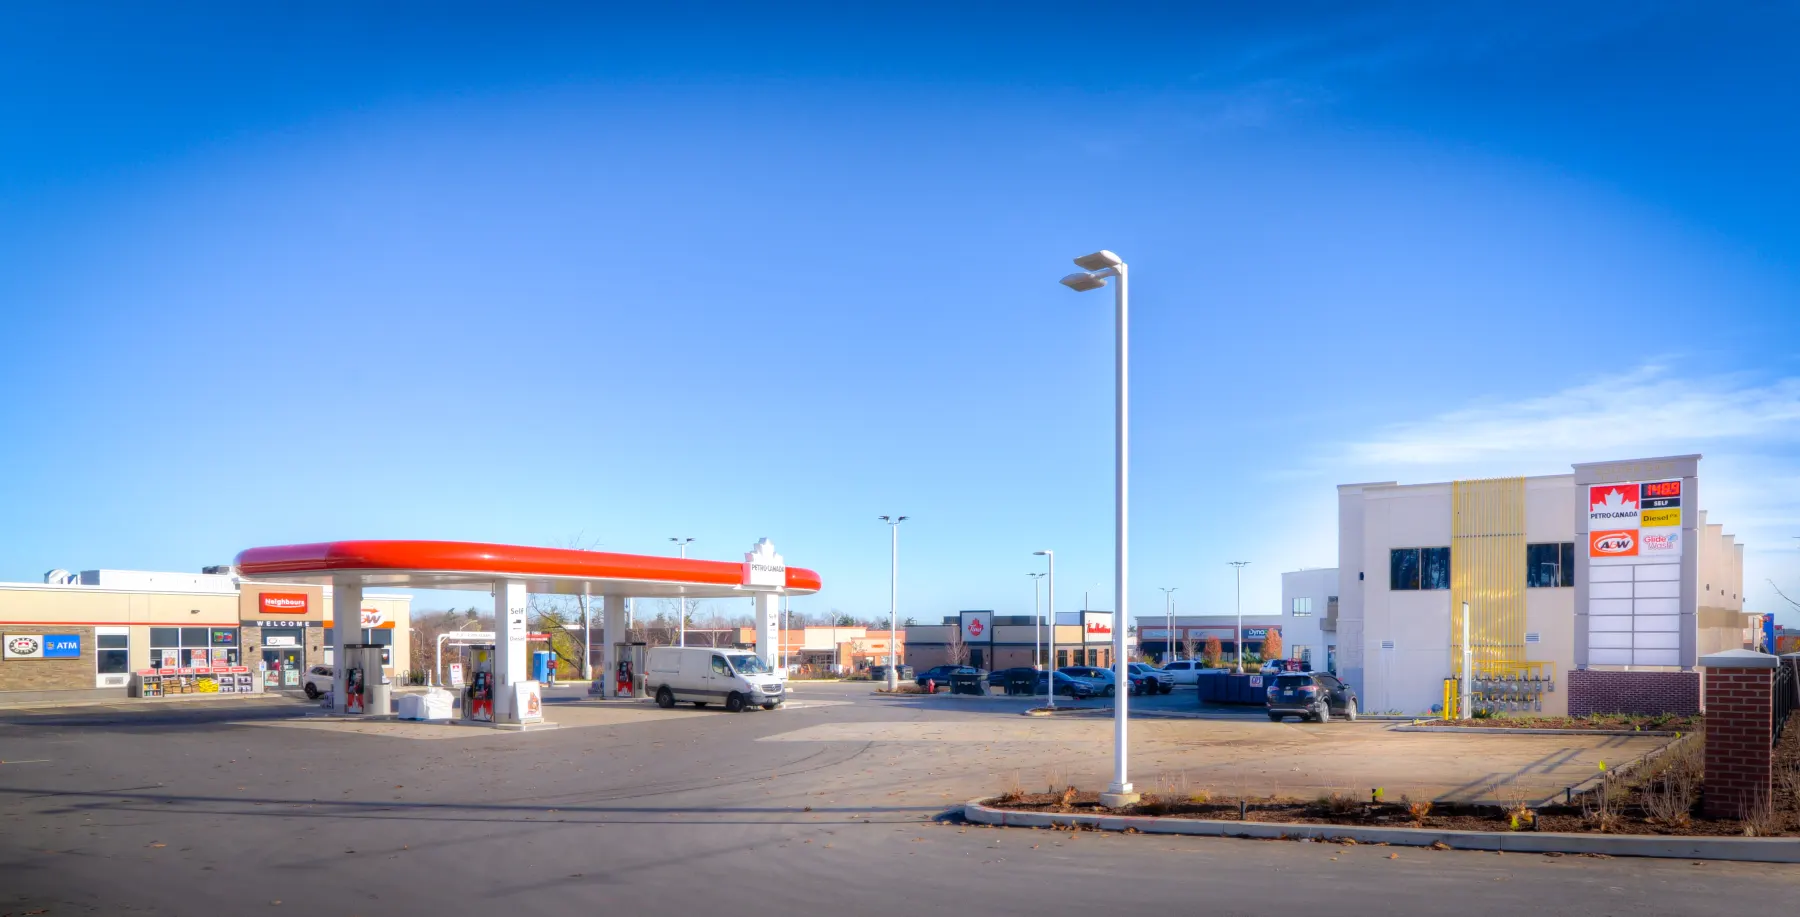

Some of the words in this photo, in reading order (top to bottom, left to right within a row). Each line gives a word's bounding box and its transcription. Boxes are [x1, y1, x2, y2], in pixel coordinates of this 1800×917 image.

[1644, 535, 1666, 543] Glide
[1601, 540, 1630, 549] A&W
[1648, 542, 1673, 550] Wash
[264, 598, 305, 606] Neighbours
[510, 607, 524, 615] Self
